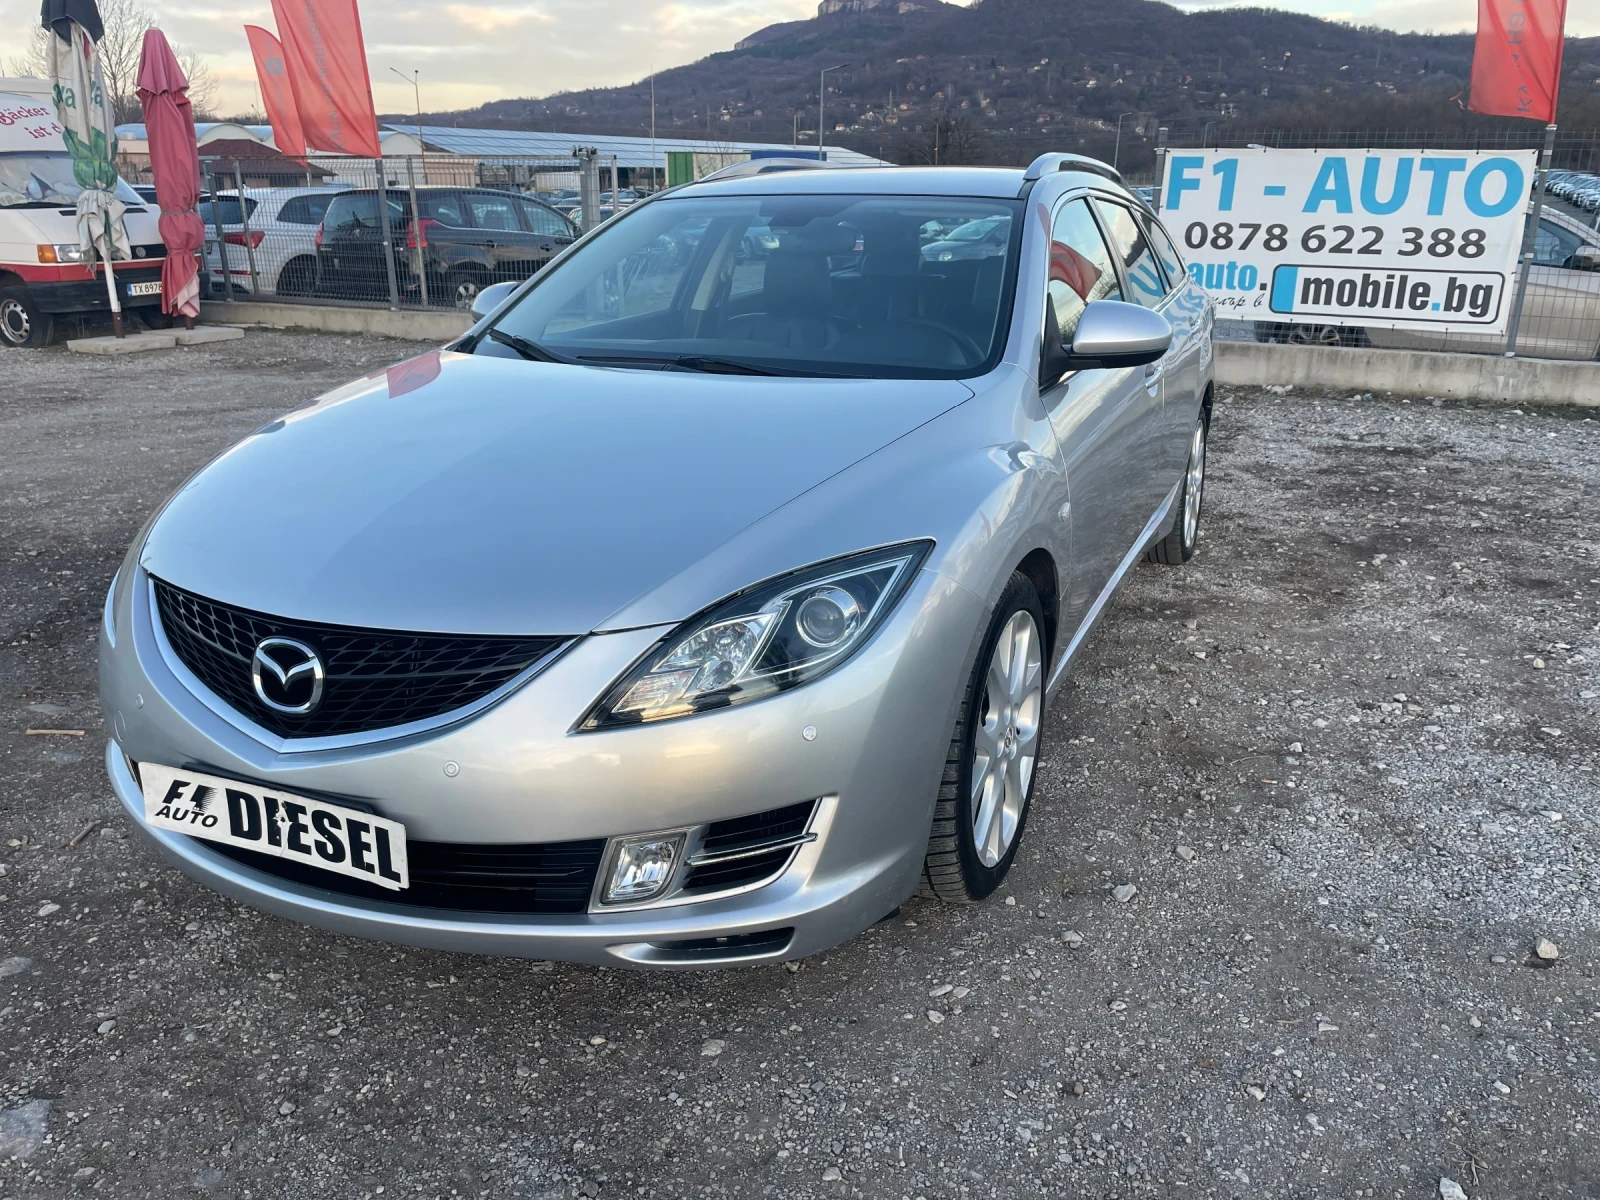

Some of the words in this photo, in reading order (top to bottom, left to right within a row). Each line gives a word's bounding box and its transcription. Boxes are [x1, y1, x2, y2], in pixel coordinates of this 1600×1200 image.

[24, 126, 52, 138] ist
[1166, 156, 1238, 211] F1
[1264, 186, 1286, 196] -
[1302, 157, 1524, 217] AUTO
[1185, 221, 1288, 252] 0878
[1301, 225, 1384, 255] 622
[1397, 227, 1486, 258] 388
[1300, 273, 1494, 318] mobile.bg
[155, 805, 218, 828] AUTO
[225, 788, 401, 883] DIESEL
